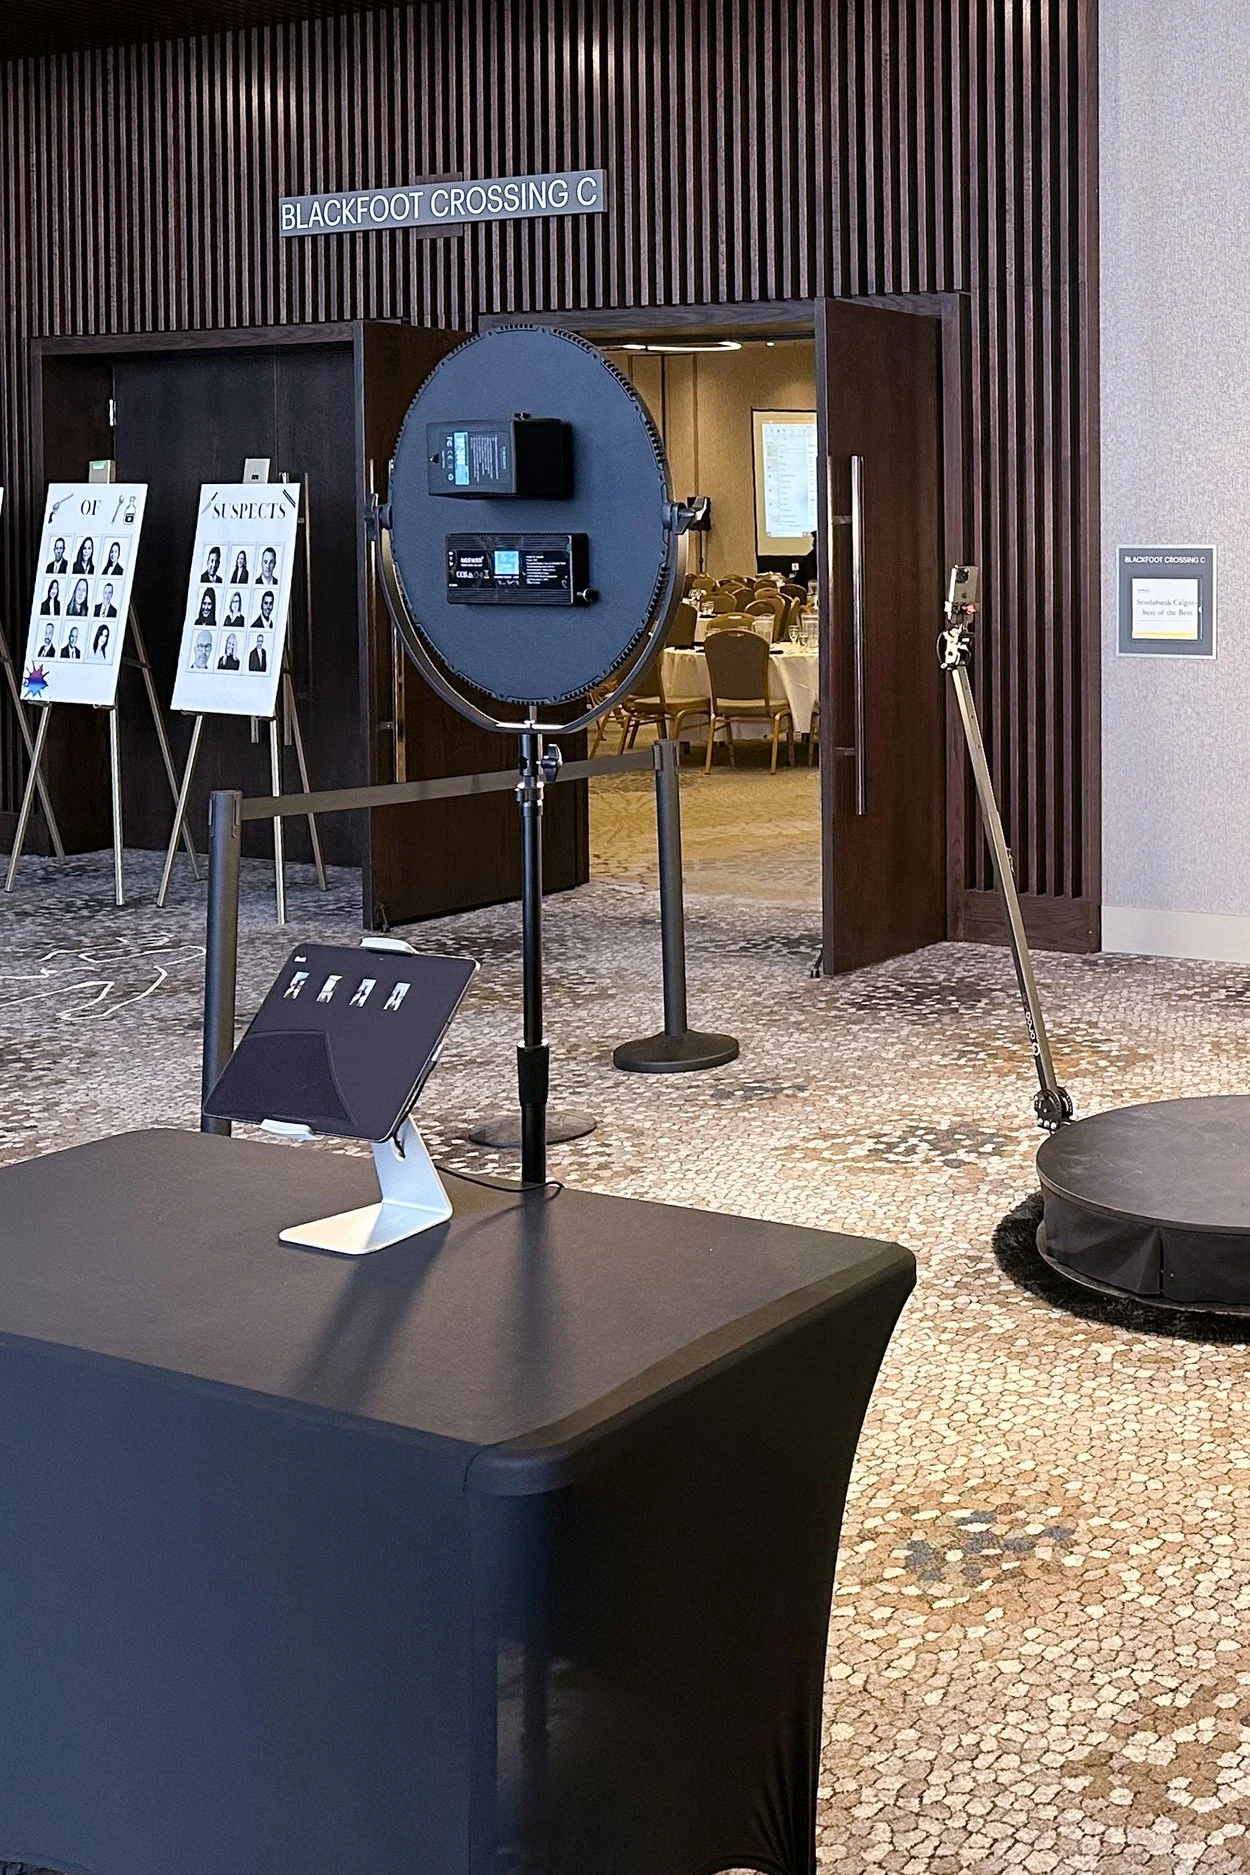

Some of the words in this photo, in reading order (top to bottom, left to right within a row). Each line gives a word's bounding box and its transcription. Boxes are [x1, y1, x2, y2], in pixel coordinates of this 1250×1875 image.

[281, 191, 423, 230] BLACKFOOT
[430, 178, 568, 218] CROSSING
[576, 176, 597, 206] C
[80, 499, 101, 516] OF
[211, 502, 287, 520] SUSPECTS
[1124, 556, 1163, 564] BLACKFOOT
[1164, 556, 1199, 564] CROSSING
[1200, 556, 1206, 564] C
